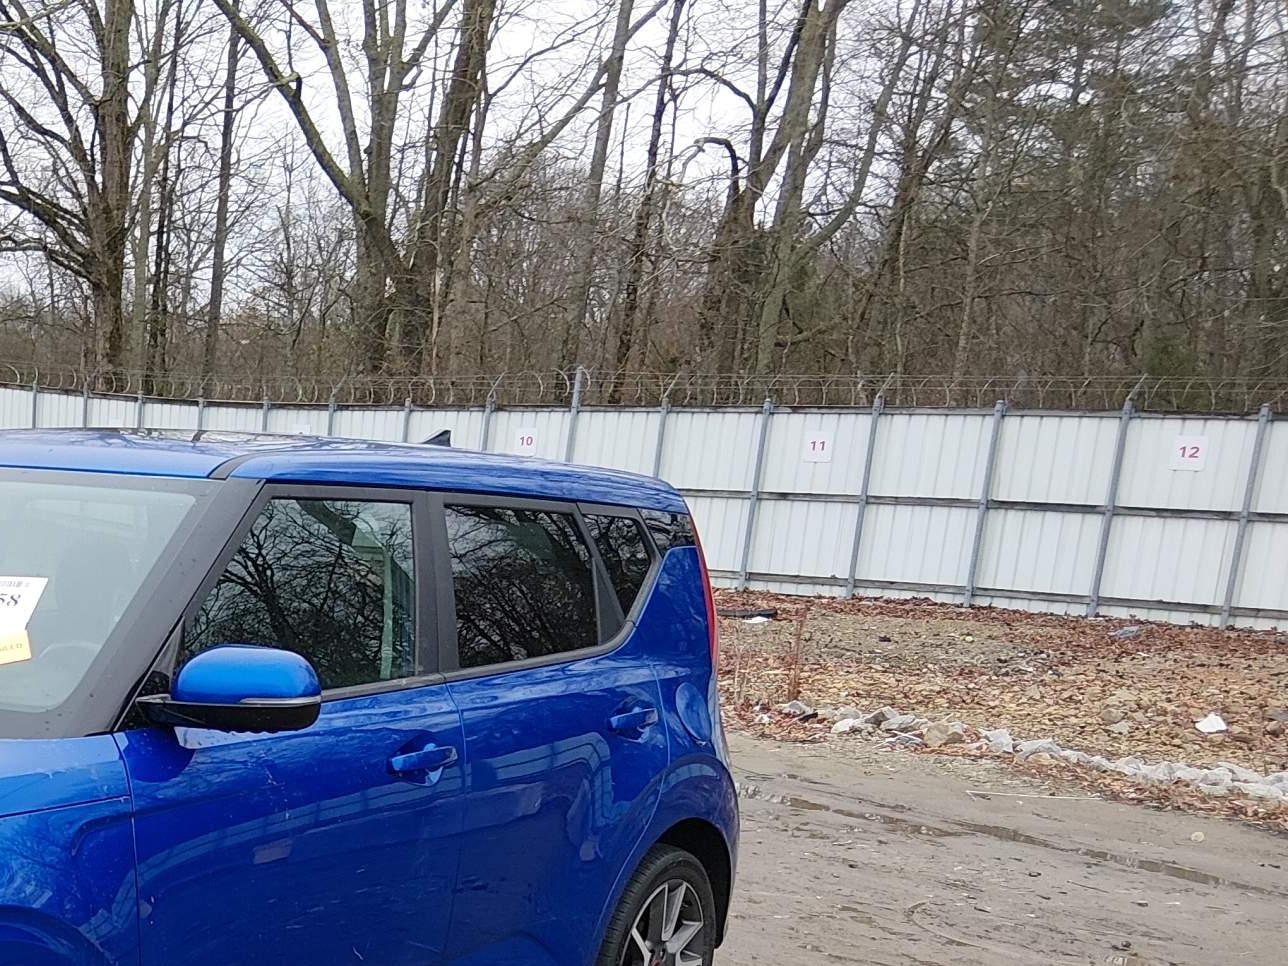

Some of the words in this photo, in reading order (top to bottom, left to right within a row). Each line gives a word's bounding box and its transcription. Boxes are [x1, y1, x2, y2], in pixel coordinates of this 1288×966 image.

[520, 436, 533, 446] 10
[810, 440, 825, 451] 11
[1179, 446, 1200, 458] 12
